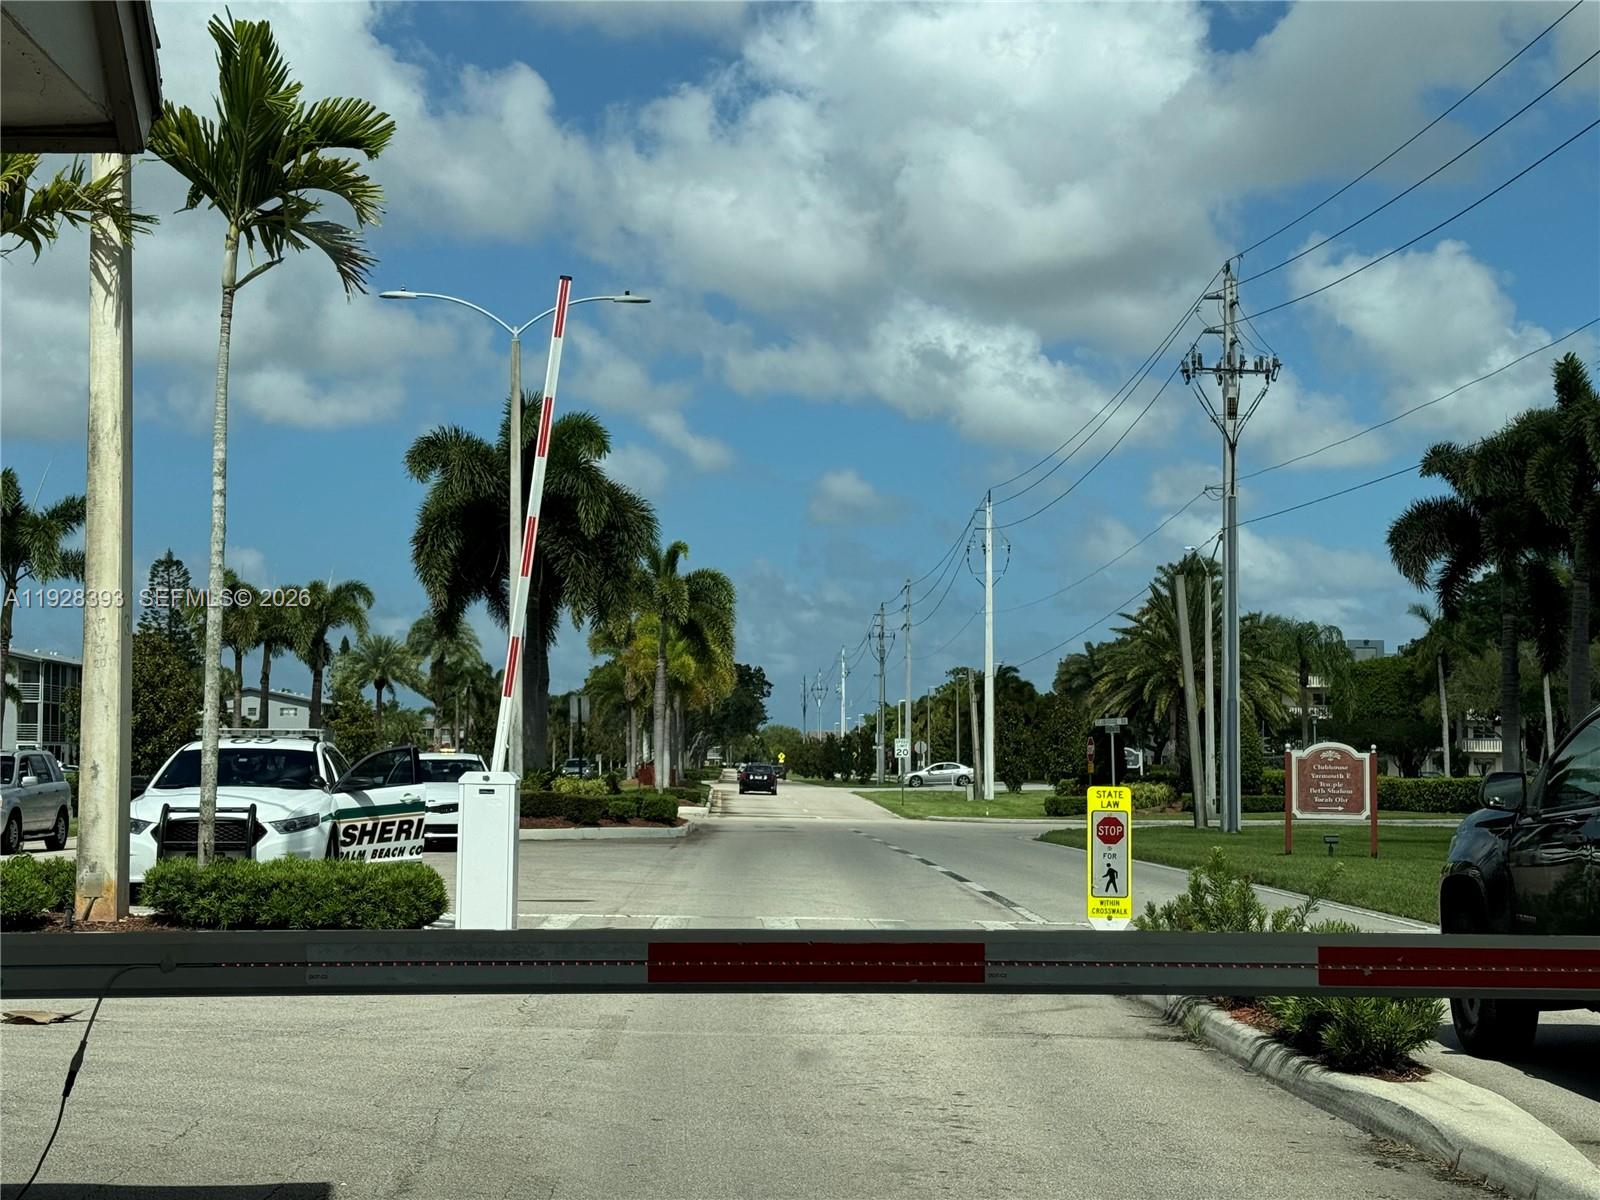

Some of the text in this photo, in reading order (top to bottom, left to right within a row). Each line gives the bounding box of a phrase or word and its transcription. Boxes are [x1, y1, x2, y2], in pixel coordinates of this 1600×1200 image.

[1096, 790, 1124, 799] STATE
[1100, 800, 1120, 809] LAW
[340, 818, 424, 847] SHERI
[1098, 825, 1123, 836] STOP
[371, 846, 406, 859] BEACH
[1103, 852, 1117, 860] FOR
[1091, 907, 1128, 915] CROSSWALK
